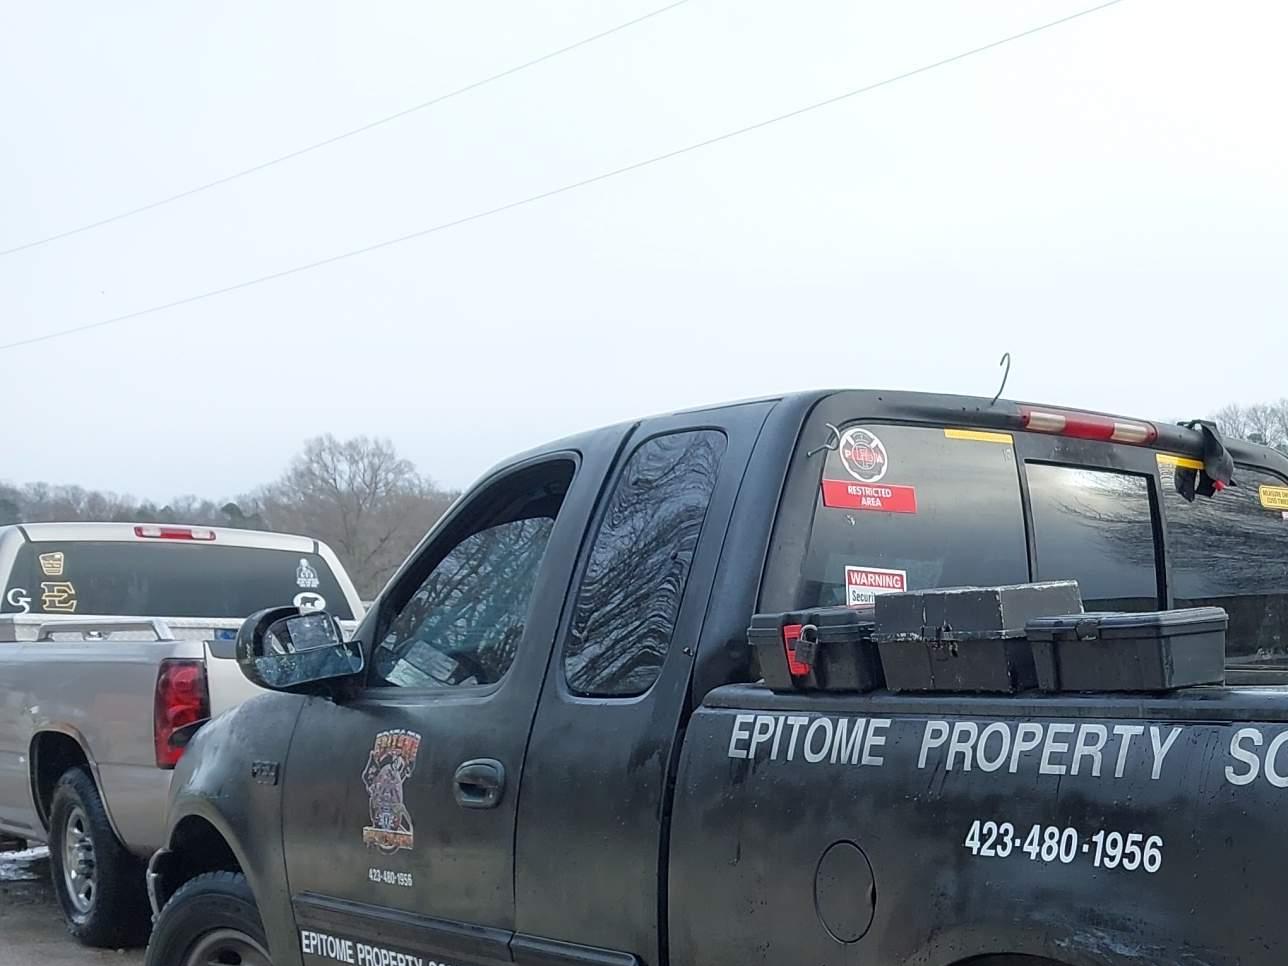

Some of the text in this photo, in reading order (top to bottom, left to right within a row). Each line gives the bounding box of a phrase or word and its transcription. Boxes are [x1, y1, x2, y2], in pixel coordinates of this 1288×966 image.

[847, 485, 892, 498] RESTRICTED
[861, 497, 882, 507] AREA
[850, 571, 902, 588] WARNING
[852, 590, 874, 603] Securi
[727, 714, 892, 767] EPITOME
[917, 720, 1183, 780] PROPERTY
[965, 819, 1164, 873] 423-480-1956
[301, 930, 355, 964] EPITOME
